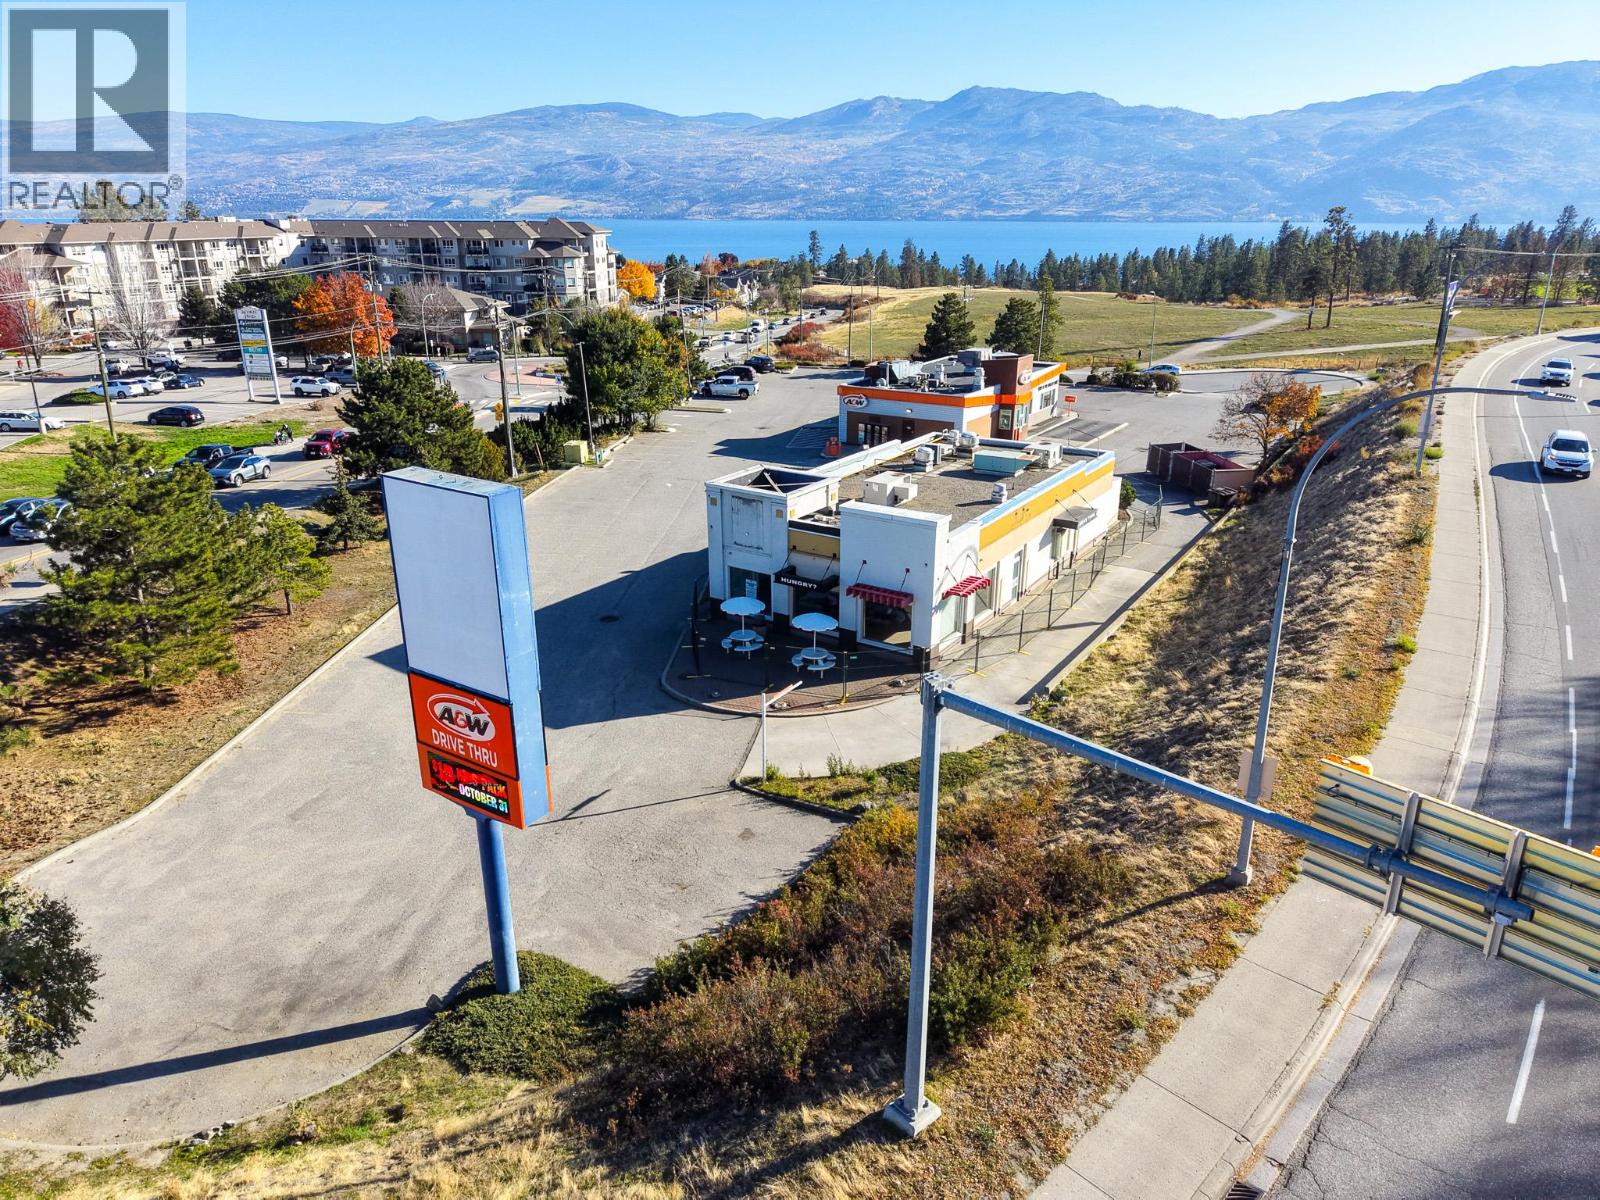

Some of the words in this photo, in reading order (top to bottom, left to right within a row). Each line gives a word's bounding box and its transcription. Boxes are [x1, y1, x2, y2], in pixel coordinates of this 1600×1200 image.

[780, 577, 818, 590] HUNGRY?
[438, 706, 490, 736] A&W
[431, 728, 465, 755] DRIVE
[467, 742, 498, 768] THRU
[458, 783, 498, 809] OCTOBER
[498, 799, 508, 813] 31
